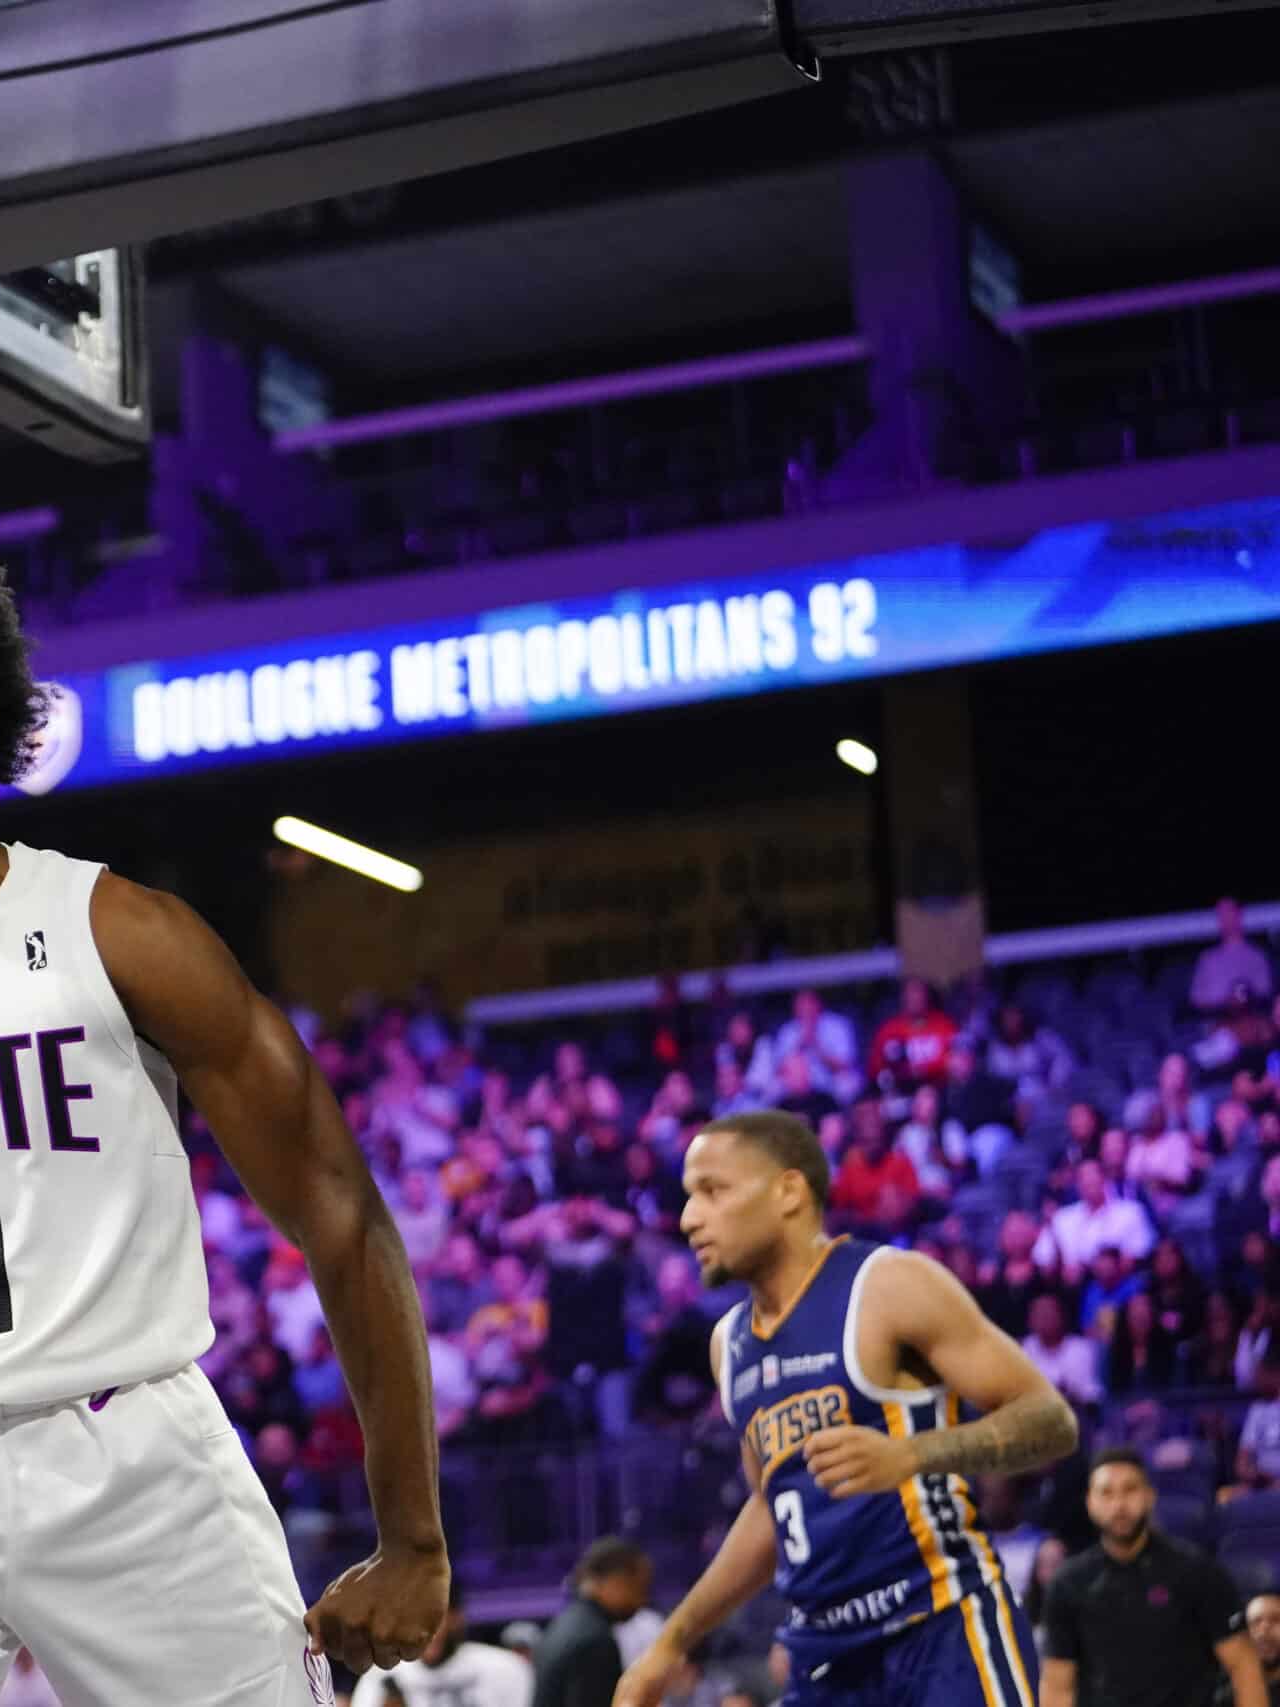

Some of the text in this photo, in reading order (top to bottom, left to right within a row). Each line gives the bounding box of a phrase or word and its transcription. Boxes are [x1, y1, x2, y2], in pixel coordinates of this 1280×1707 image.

[133, 579, 877, 763] BOULOGNE METROPOLITANS 92
[774, 1489, 811, 1565] 3
